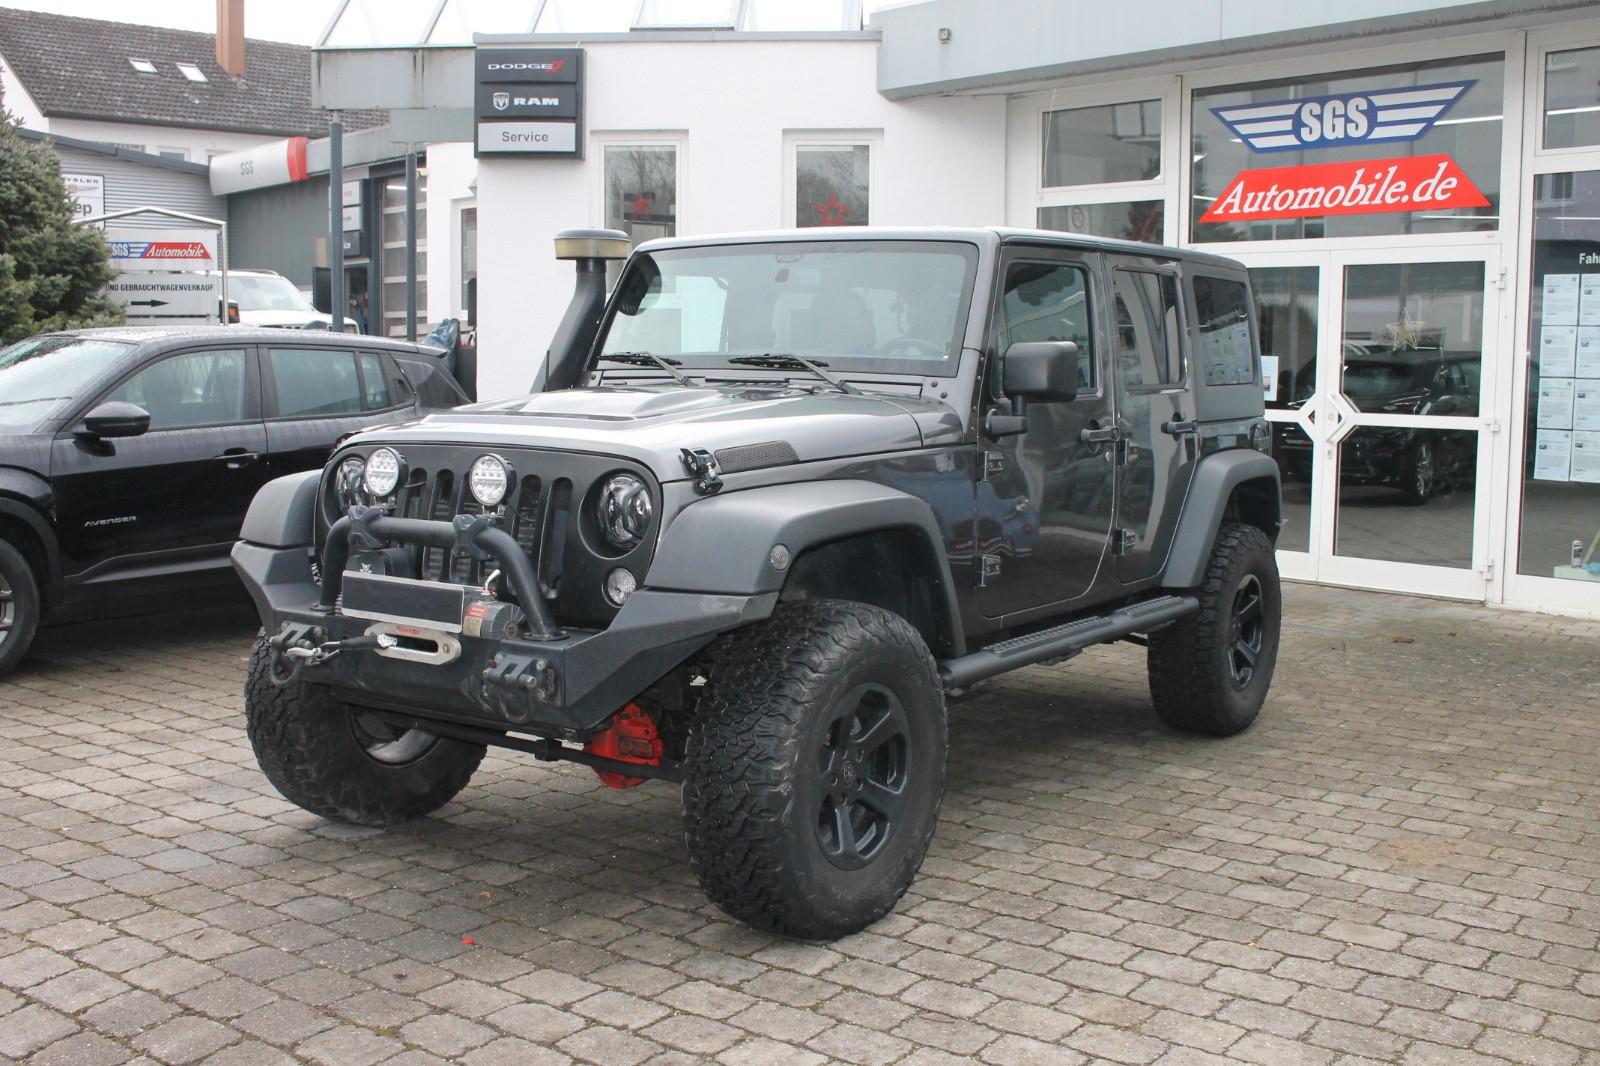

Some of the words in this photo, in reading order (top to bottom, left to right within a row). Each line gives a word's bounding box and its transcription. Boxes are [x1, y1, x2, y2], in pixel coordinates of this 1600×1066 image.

[487, 63, 554, 71] DODGE
[513, 97, 560, 106] RAM
[1300, 96, 1369, 143] SGS
[501, 131, 549, 143] Service
[240, 160, 255, 176] SGS
[1213, 160, 1459, 215] Automobile.de
[74, 203, 93, 217] ep
[111, 243, 129, 257] SGS
[146, 244, 205, 258] Automobile
[120, 283, 214, 292] GEBRAUCHTWAGENVERKAUF
[84, 515, 137, 527] AVENGER
